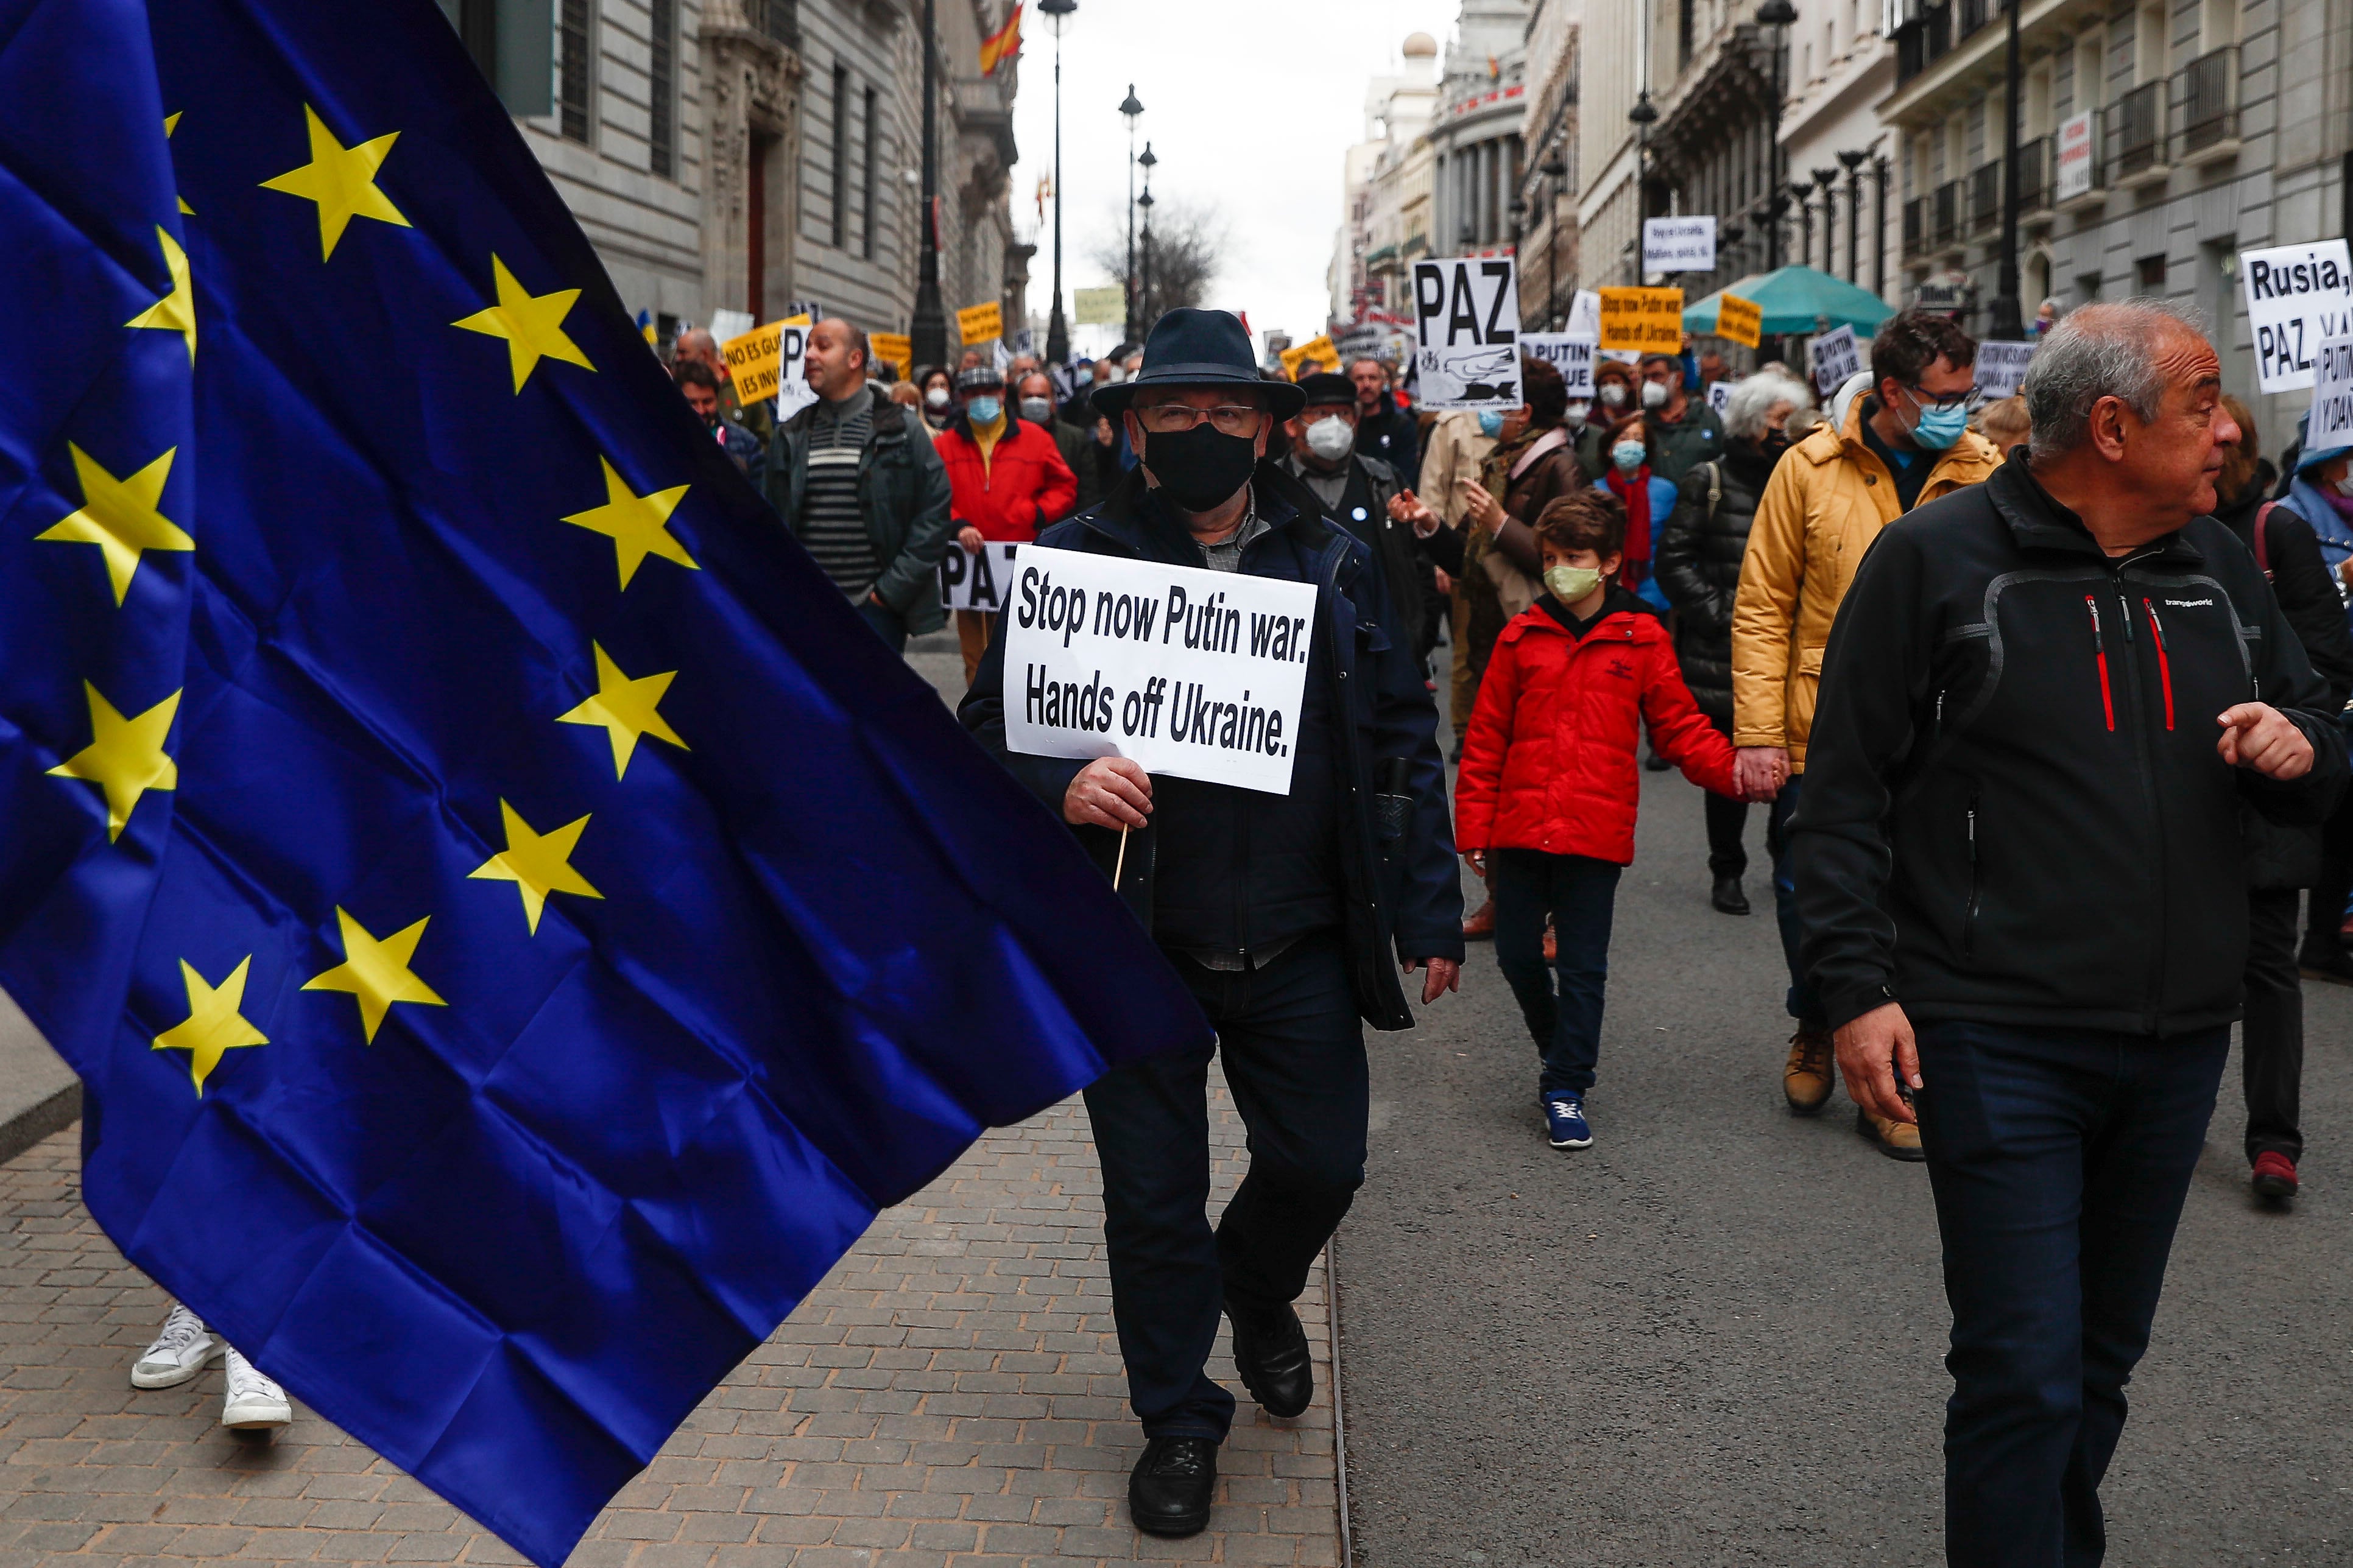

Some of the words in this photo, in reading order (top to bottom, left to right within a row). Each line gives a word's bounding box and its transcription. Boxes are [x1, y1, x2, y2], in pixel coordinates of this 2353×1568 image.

[2249, 253, 2349, 300] Rusia,
[1416, 262, 1514, 345] PAZ
[725, 347, 746, 367] NO
[746, 341, 761, 361] ES
[762, 332, 781, 356] GU
[783, 328, 805, 379] P
[1536, 344, 1590, 362] PUTIN
[1824, 334, 1852, 358] PUTIN
[758, 366, 780, 388] INV
[940, 544, 1017, 605] PA
[1018, 566, 1086, 648] Stop
[1093, 591, 1159, 642] now
[1163, 585, 1240, 654] Putin
[1251, 612, 1306, 664] war.
[1026, 663, 1114, 733] Hands
[1123, 676, 1167, 739] off
[1170, 681, 1288, 758] Ukraine.
